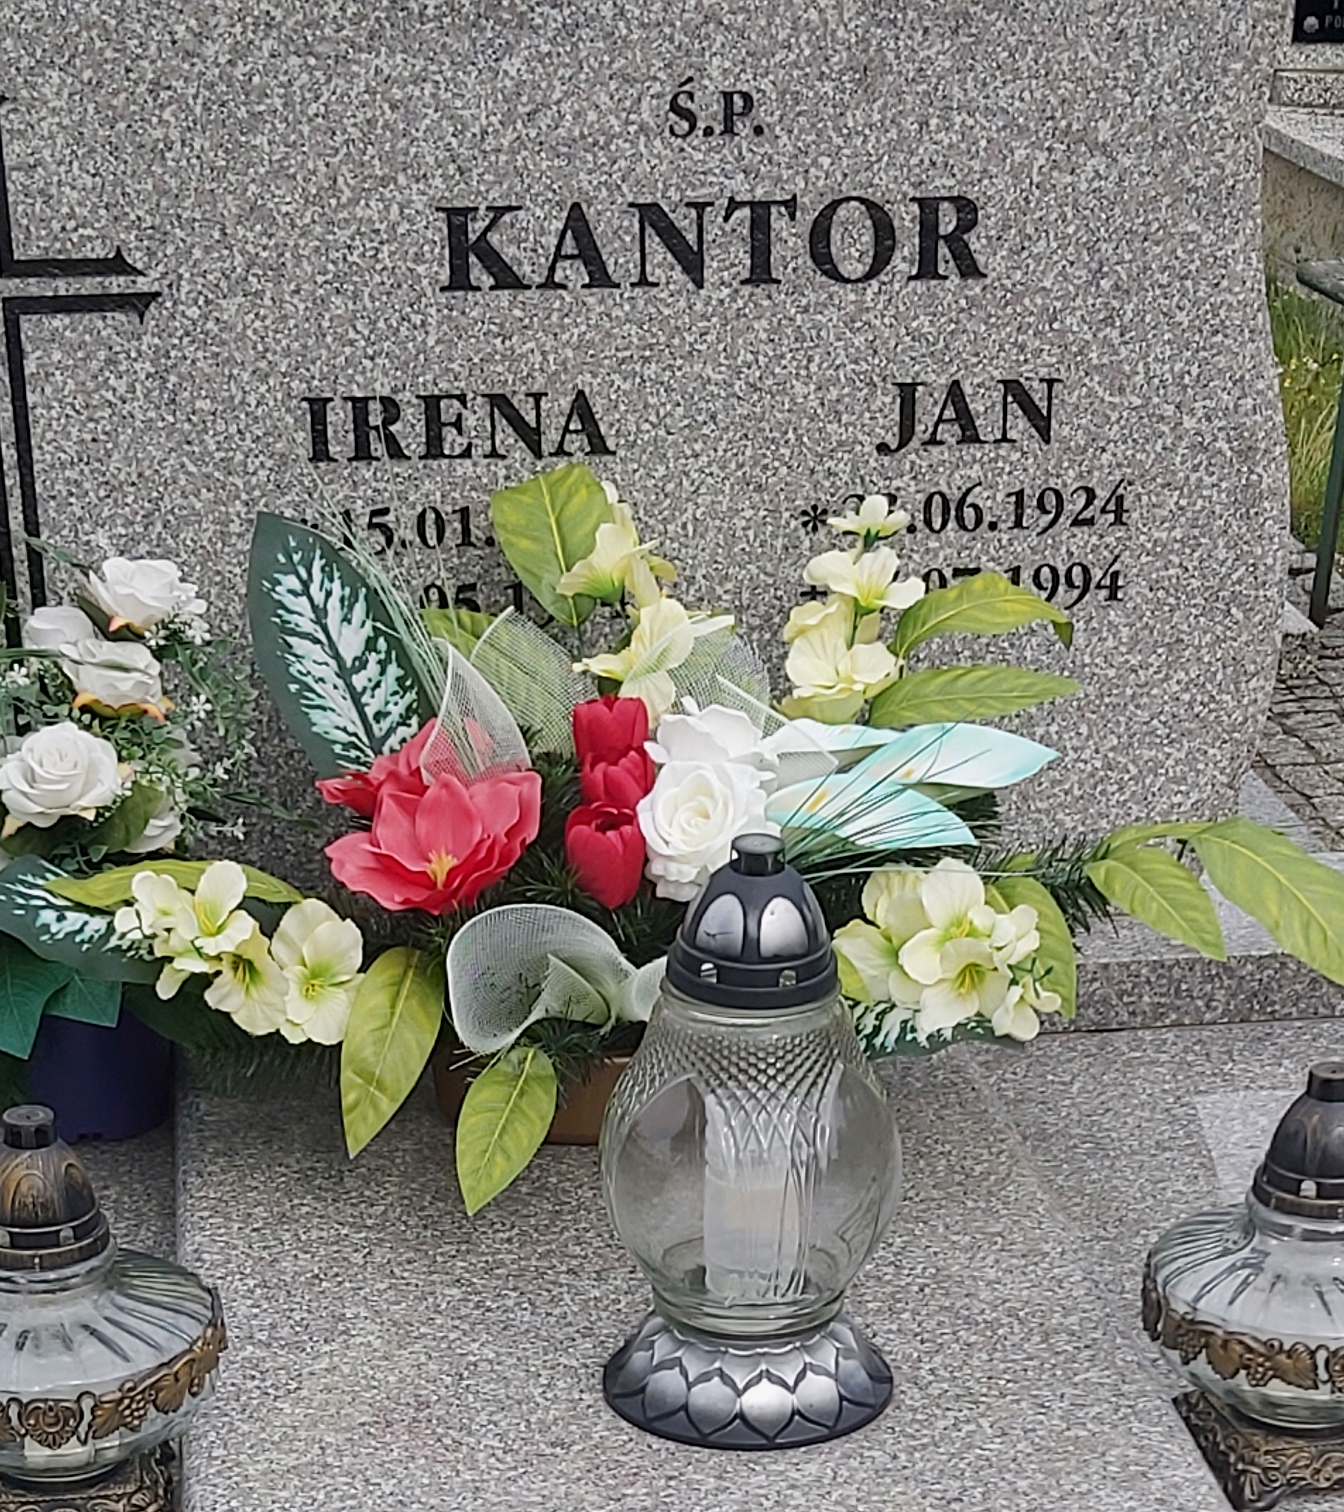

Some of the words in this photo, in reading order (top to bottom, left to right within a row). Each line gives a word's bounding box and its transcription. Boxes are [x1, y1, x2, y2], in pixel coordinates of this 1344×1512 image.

[667, 76, 765, 138] Ś.P.
[435, 195, 987, 293] KANTOR
[303, 389, 617, 463] IRENA
[876, 377, 1064, 456] JAN
